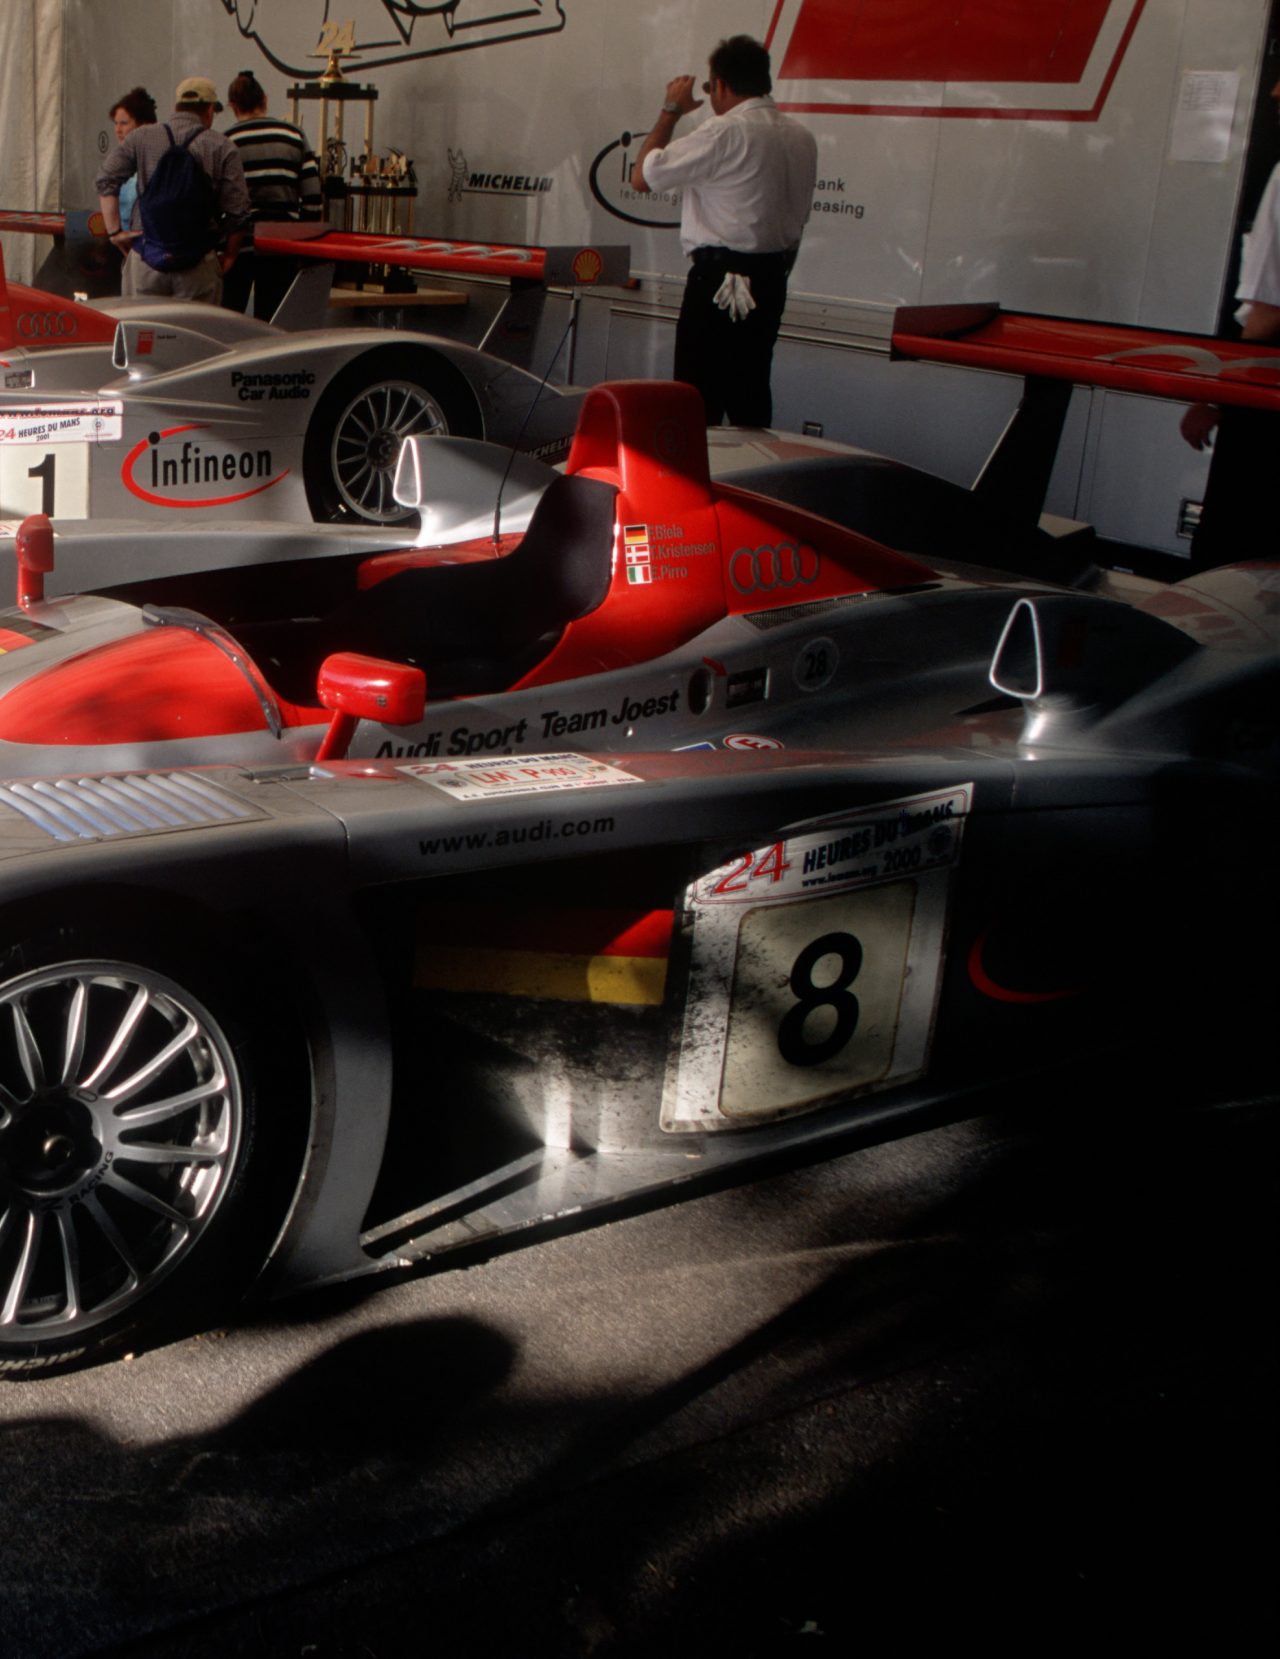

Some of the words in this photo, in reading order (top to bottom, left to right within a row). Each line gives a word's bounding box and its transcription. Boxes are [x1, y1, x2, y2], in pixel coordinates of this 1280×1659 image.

[316, 20, 355, 55] 24
[468, 173, 553, 192] MICHELIN
[815, 177, 846, 191] ank
[813, 200, 864, 219] easing
[231, 369, 316, 388] Panasonic
[238, 387, 265, 401] Car
[268, 385, 311, 401] Audio
[18, 423, 46, 439] HEURES
[47, 422, 58, 433] DU
[59, 417, 81, 430] MANS
[36, 433, 50, 442] 2001
[151, 442, 272, 488] Infineon
[28, 453, 56, 518] 1
[375, 733, 441, 759] Audi
[447, 717, 528, 756] Sport
[541, 708, 608, 739] Team
[612, 690, 680, 725] Joest
[410, 762, 458, 775] 24
[464, 758, 518, 769] HEURES
[519, 756, 537, 764] DU
[538, 752, 579, 762] MANS
[419, 815, 616, 856] www.audi.com
[710, 841, 791, 895] 24
[802, 829, 871, 875] HEURES
[874, 819, 898, 848] DU
[884, 846, 921, 872] 2000
[777, 932, 864, 1067] 8
